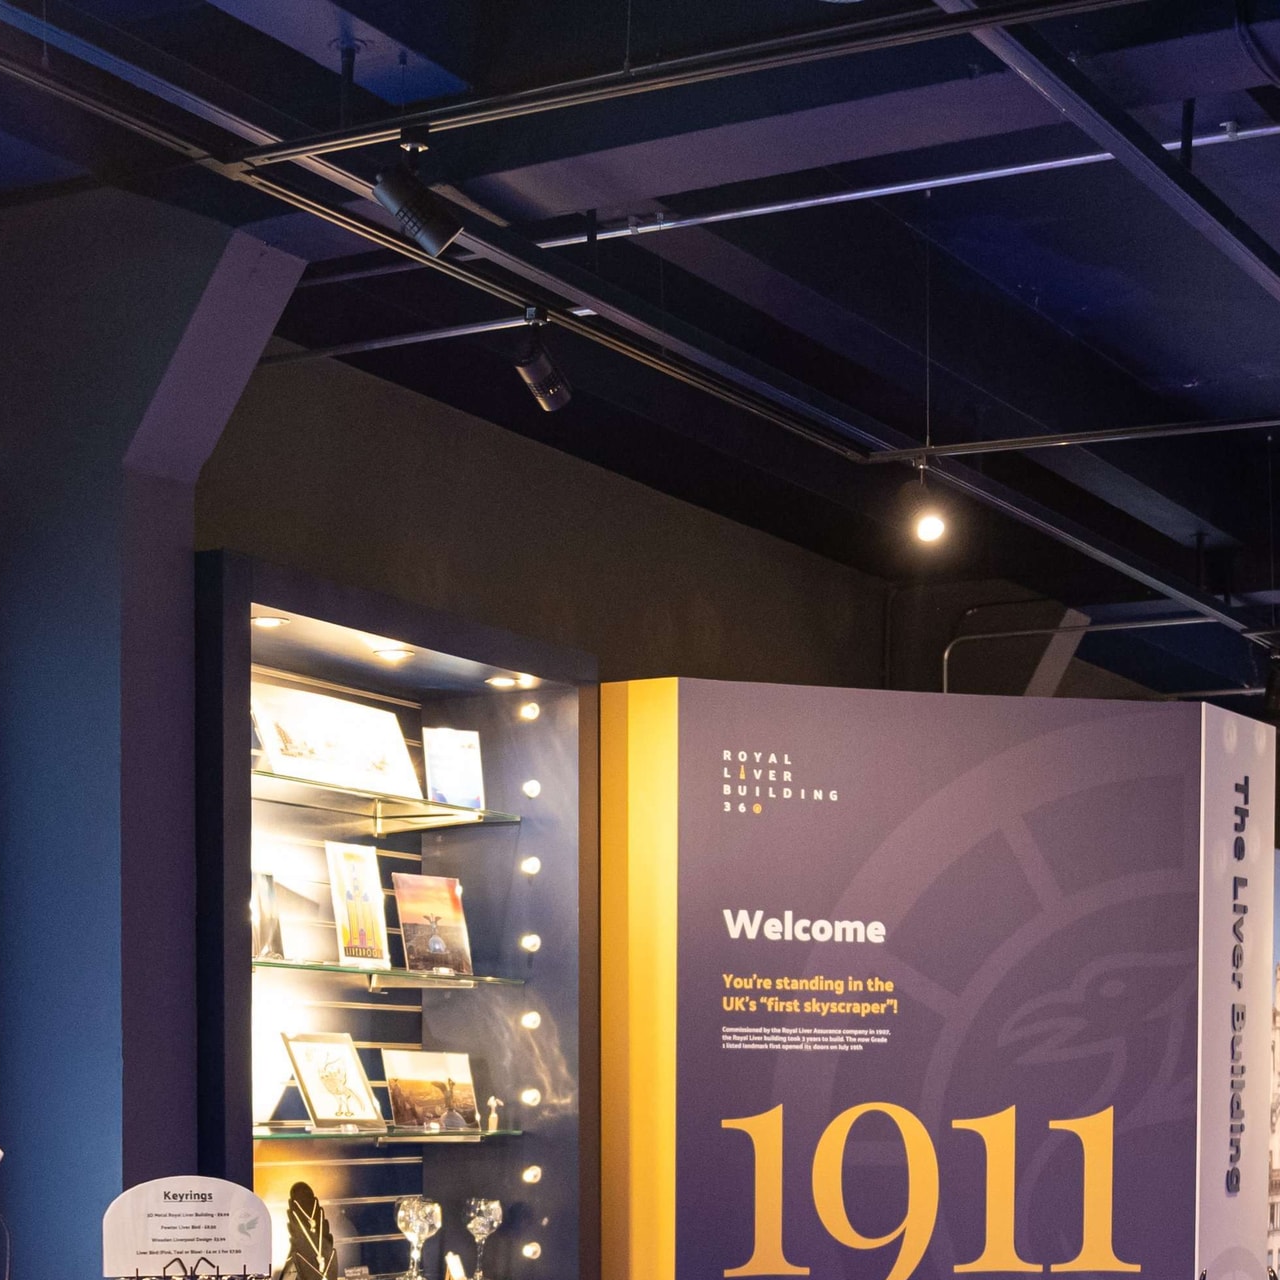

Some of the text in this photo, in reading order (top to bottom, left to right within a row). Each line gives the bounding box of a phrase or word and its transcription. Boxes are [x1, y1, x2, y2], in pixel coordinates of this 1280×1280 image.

[723, 749, 792, 765] ROYAL
[723, 783, 839, 801] BUILDING
[1232, 774, 1250, 863] The
[722, 908, 887, 943] Welcome
[1230, 875, 1249, 992] Liver
[775, 976, 845, 995] standing
[848, 976, 864, 991] in
[866, 976, 895, 992] the
[1224, 1002, 1247, 1196] Building
[163, 1190, 213, 1203] Keyrings
